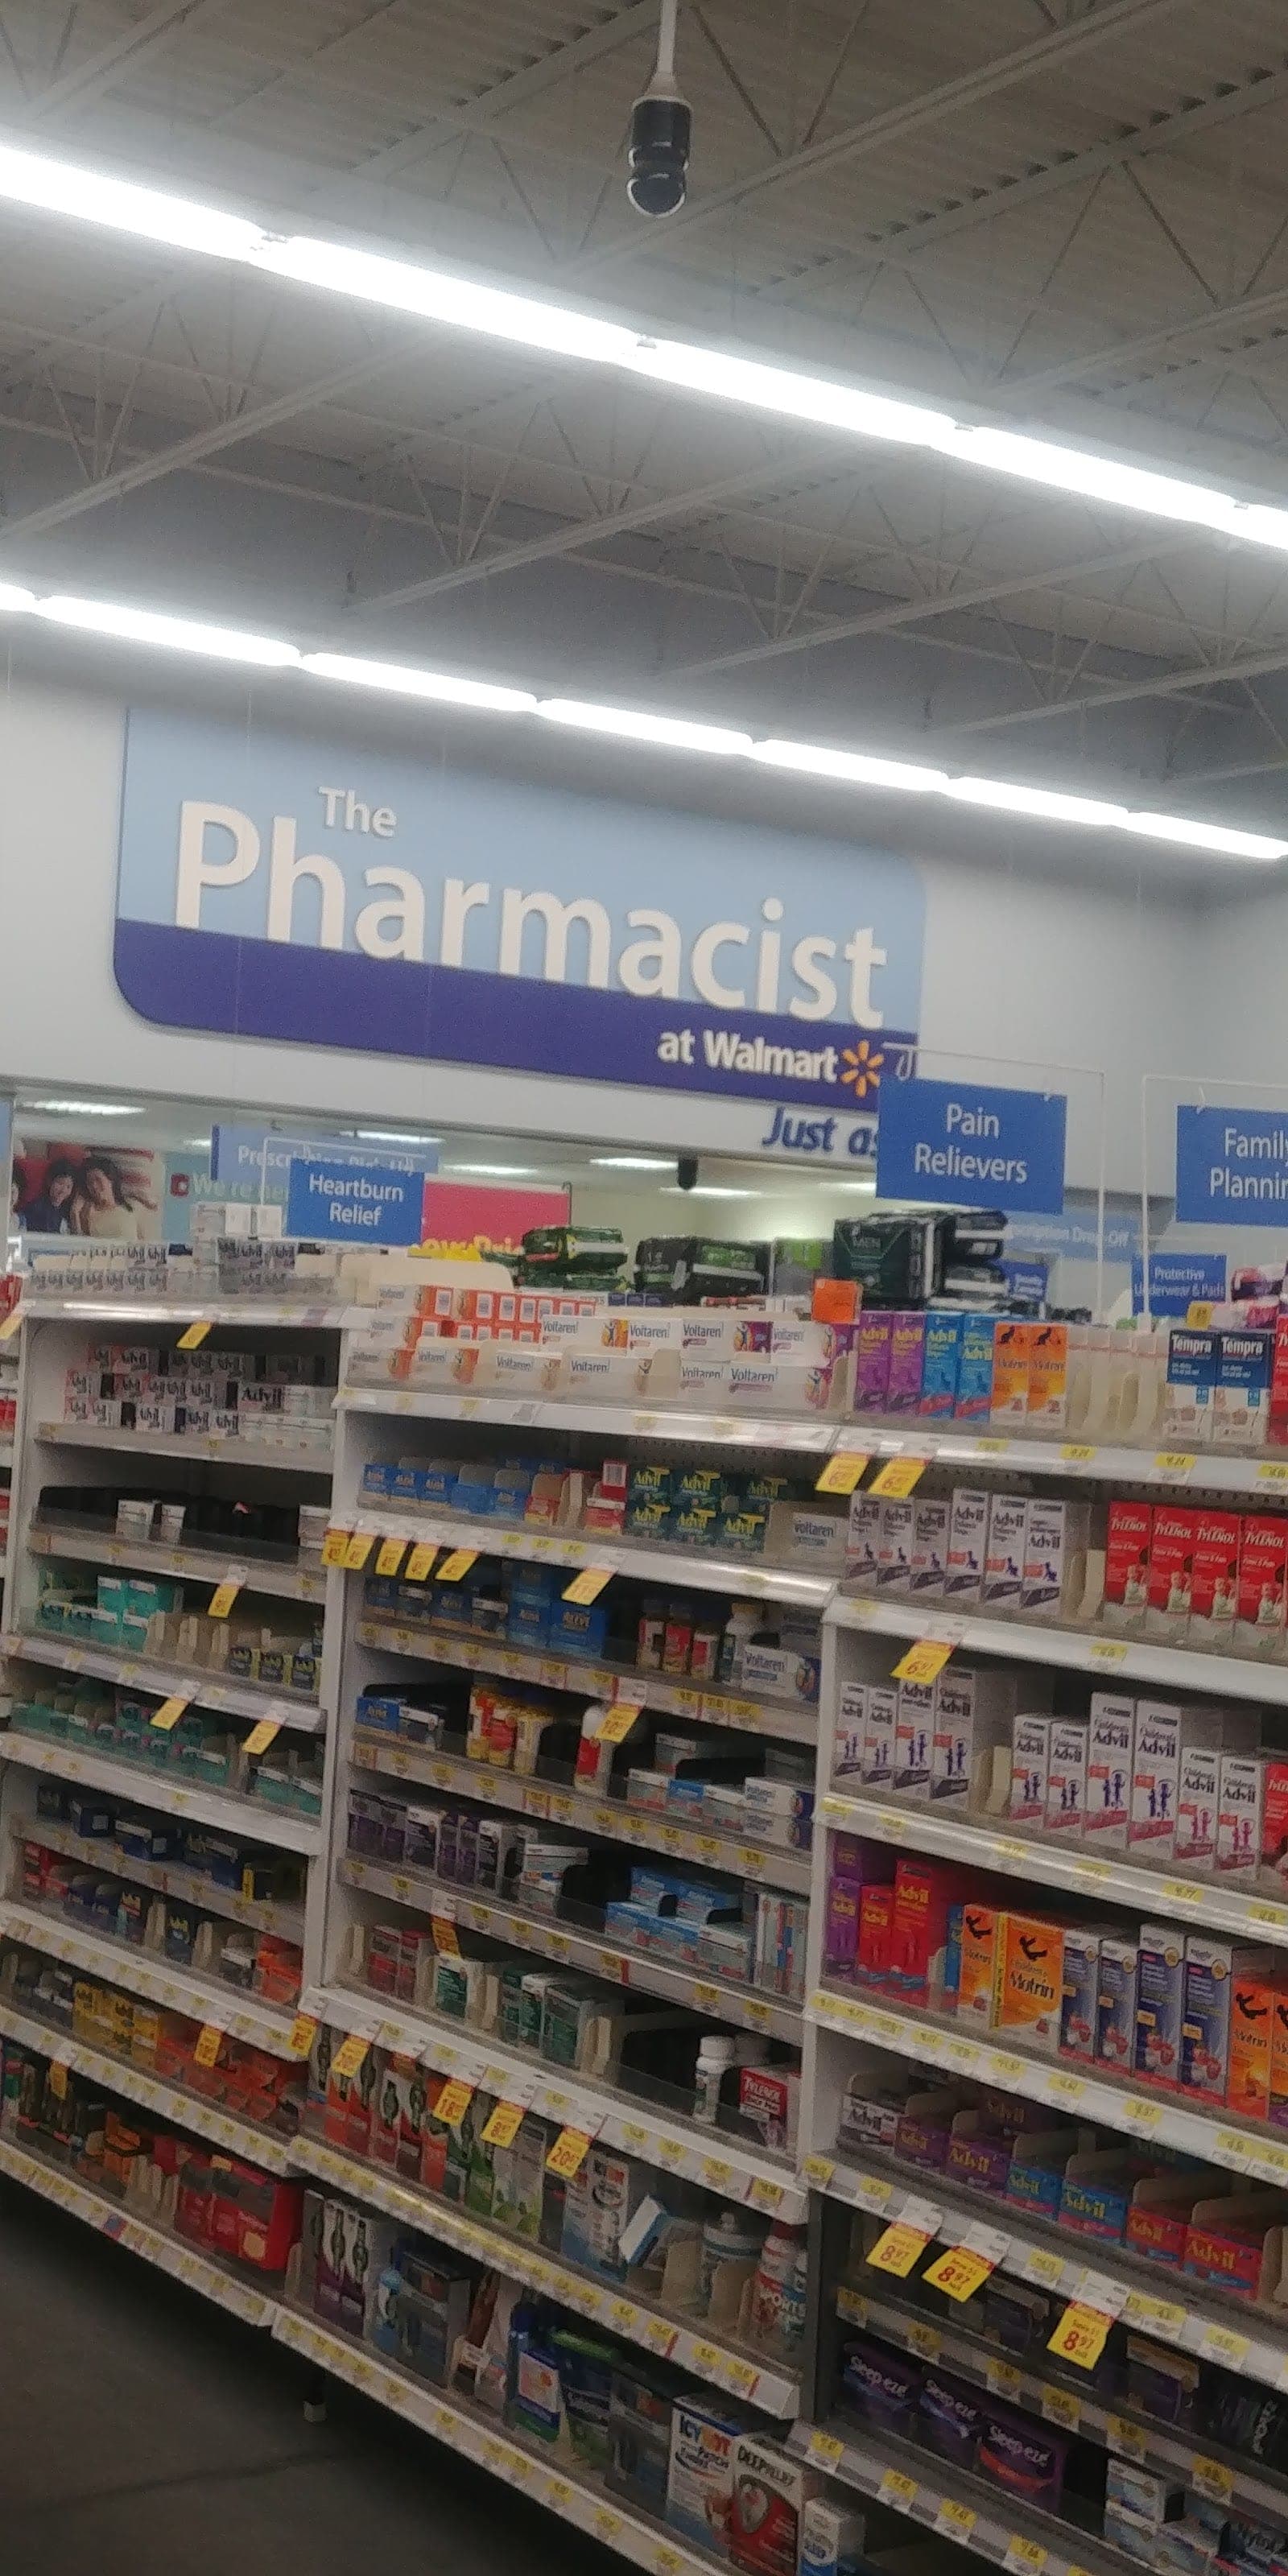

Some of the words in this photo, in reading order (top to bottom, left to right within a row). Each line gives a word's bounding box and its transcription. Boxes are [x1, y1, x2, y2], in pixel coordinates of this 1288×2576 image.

[319, 786, 398, 838] The
[175, 799, 889, 1030] Pharmacist
[657, 1030, 696, 1065] at
[703, 1030, 839, 1084] Walmart
[762, 1107, 838, 1153] Just
[946, 1102, 1001, 1140] Pain
[1224, 1126, 1288, 1167] Famil
[914, 1141, 1028, 1184] Relievers
[309, 1174, 404, 1202] Heartburn
[328, 1203, 382, 1227] Relief
[1154, 1266, 1205, 1282] Protective
[1135, 1282, 1190, 1297] Uderwear
[630, 1323, 668, 1339] Voltaren
[683, 1323, 723, 1339] Voltaren
[1172, 1333, 1212, 1355] Tempra
[1221, 1336, 1264, 1356] Tempra
[1092, 1731, 1129, 1749] Advil
[1137, 1738, 1176, 1758] Advil
[1183, 1776, 1215, 1794] Advil
[1222, 1787, 1256, 1804] Advil
[1009, 1971, 1055, 2000] Motrin
